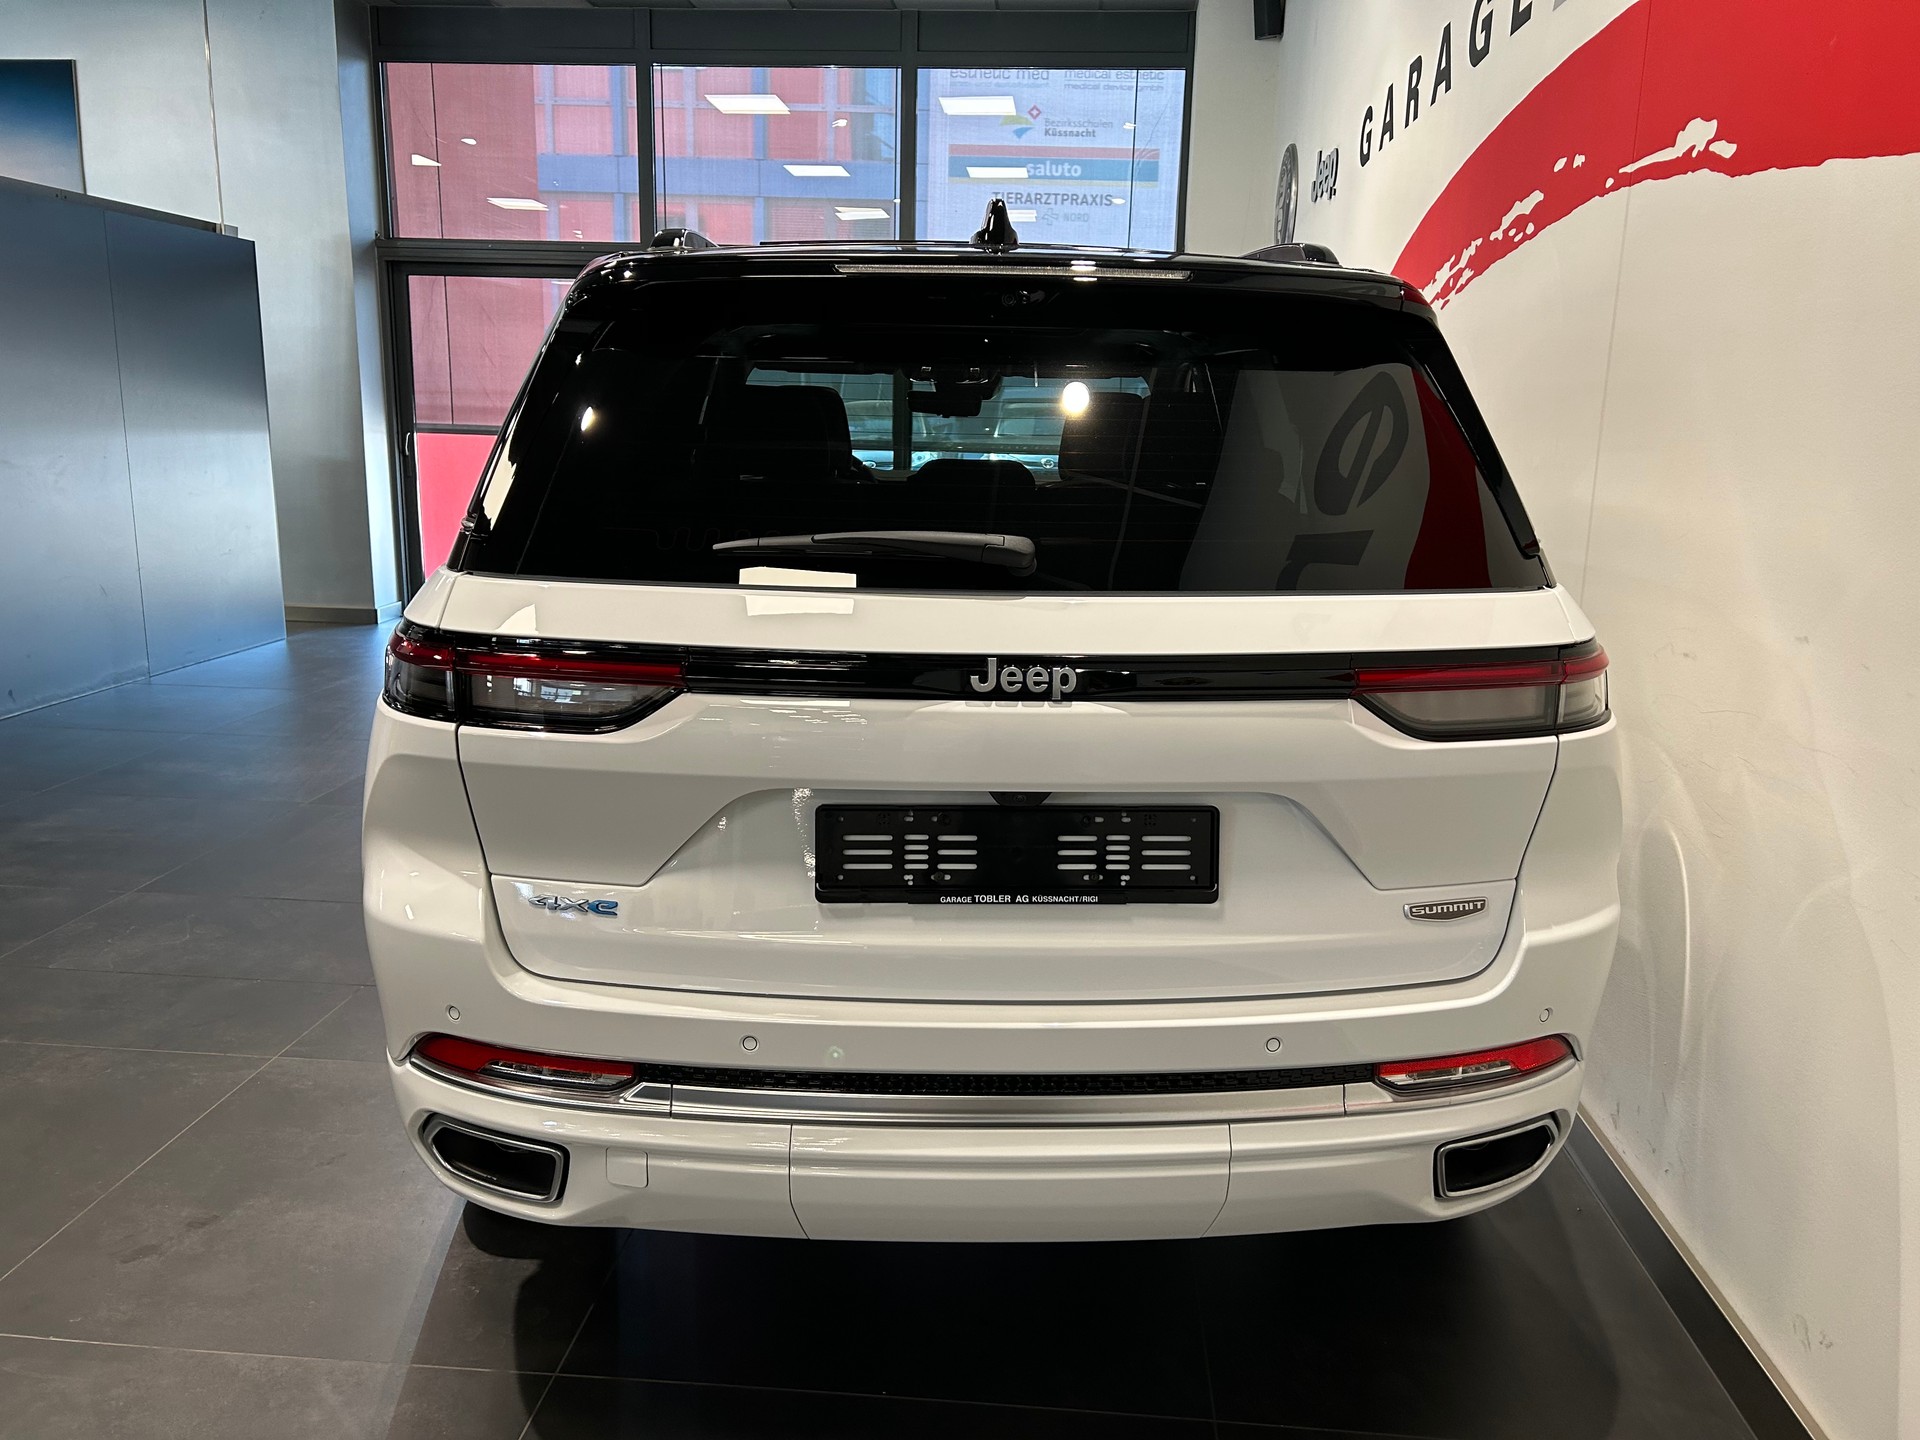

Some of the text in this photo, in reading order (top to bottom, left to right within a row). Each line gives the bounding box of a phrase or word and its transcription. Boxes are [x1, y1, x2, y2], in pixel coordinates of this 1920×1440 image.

[1044, 128, 1097, 138] Küssnacht
[1026, 160, 1082, 177] saluto
[992, 191, 1113, 206] TIERARZTPRAXIS
[1063, 213, 1089, 223] NORD
[970, 657, 1077, 700] Jeep
[974, 894, 1011, 903] TOBLER
[1015, 894, 1030, 903] AG
[1032, 894, 1099, 903] KÜSSNACHT/RIGI
[1411, 901, 1484, 916] SUMMIT
